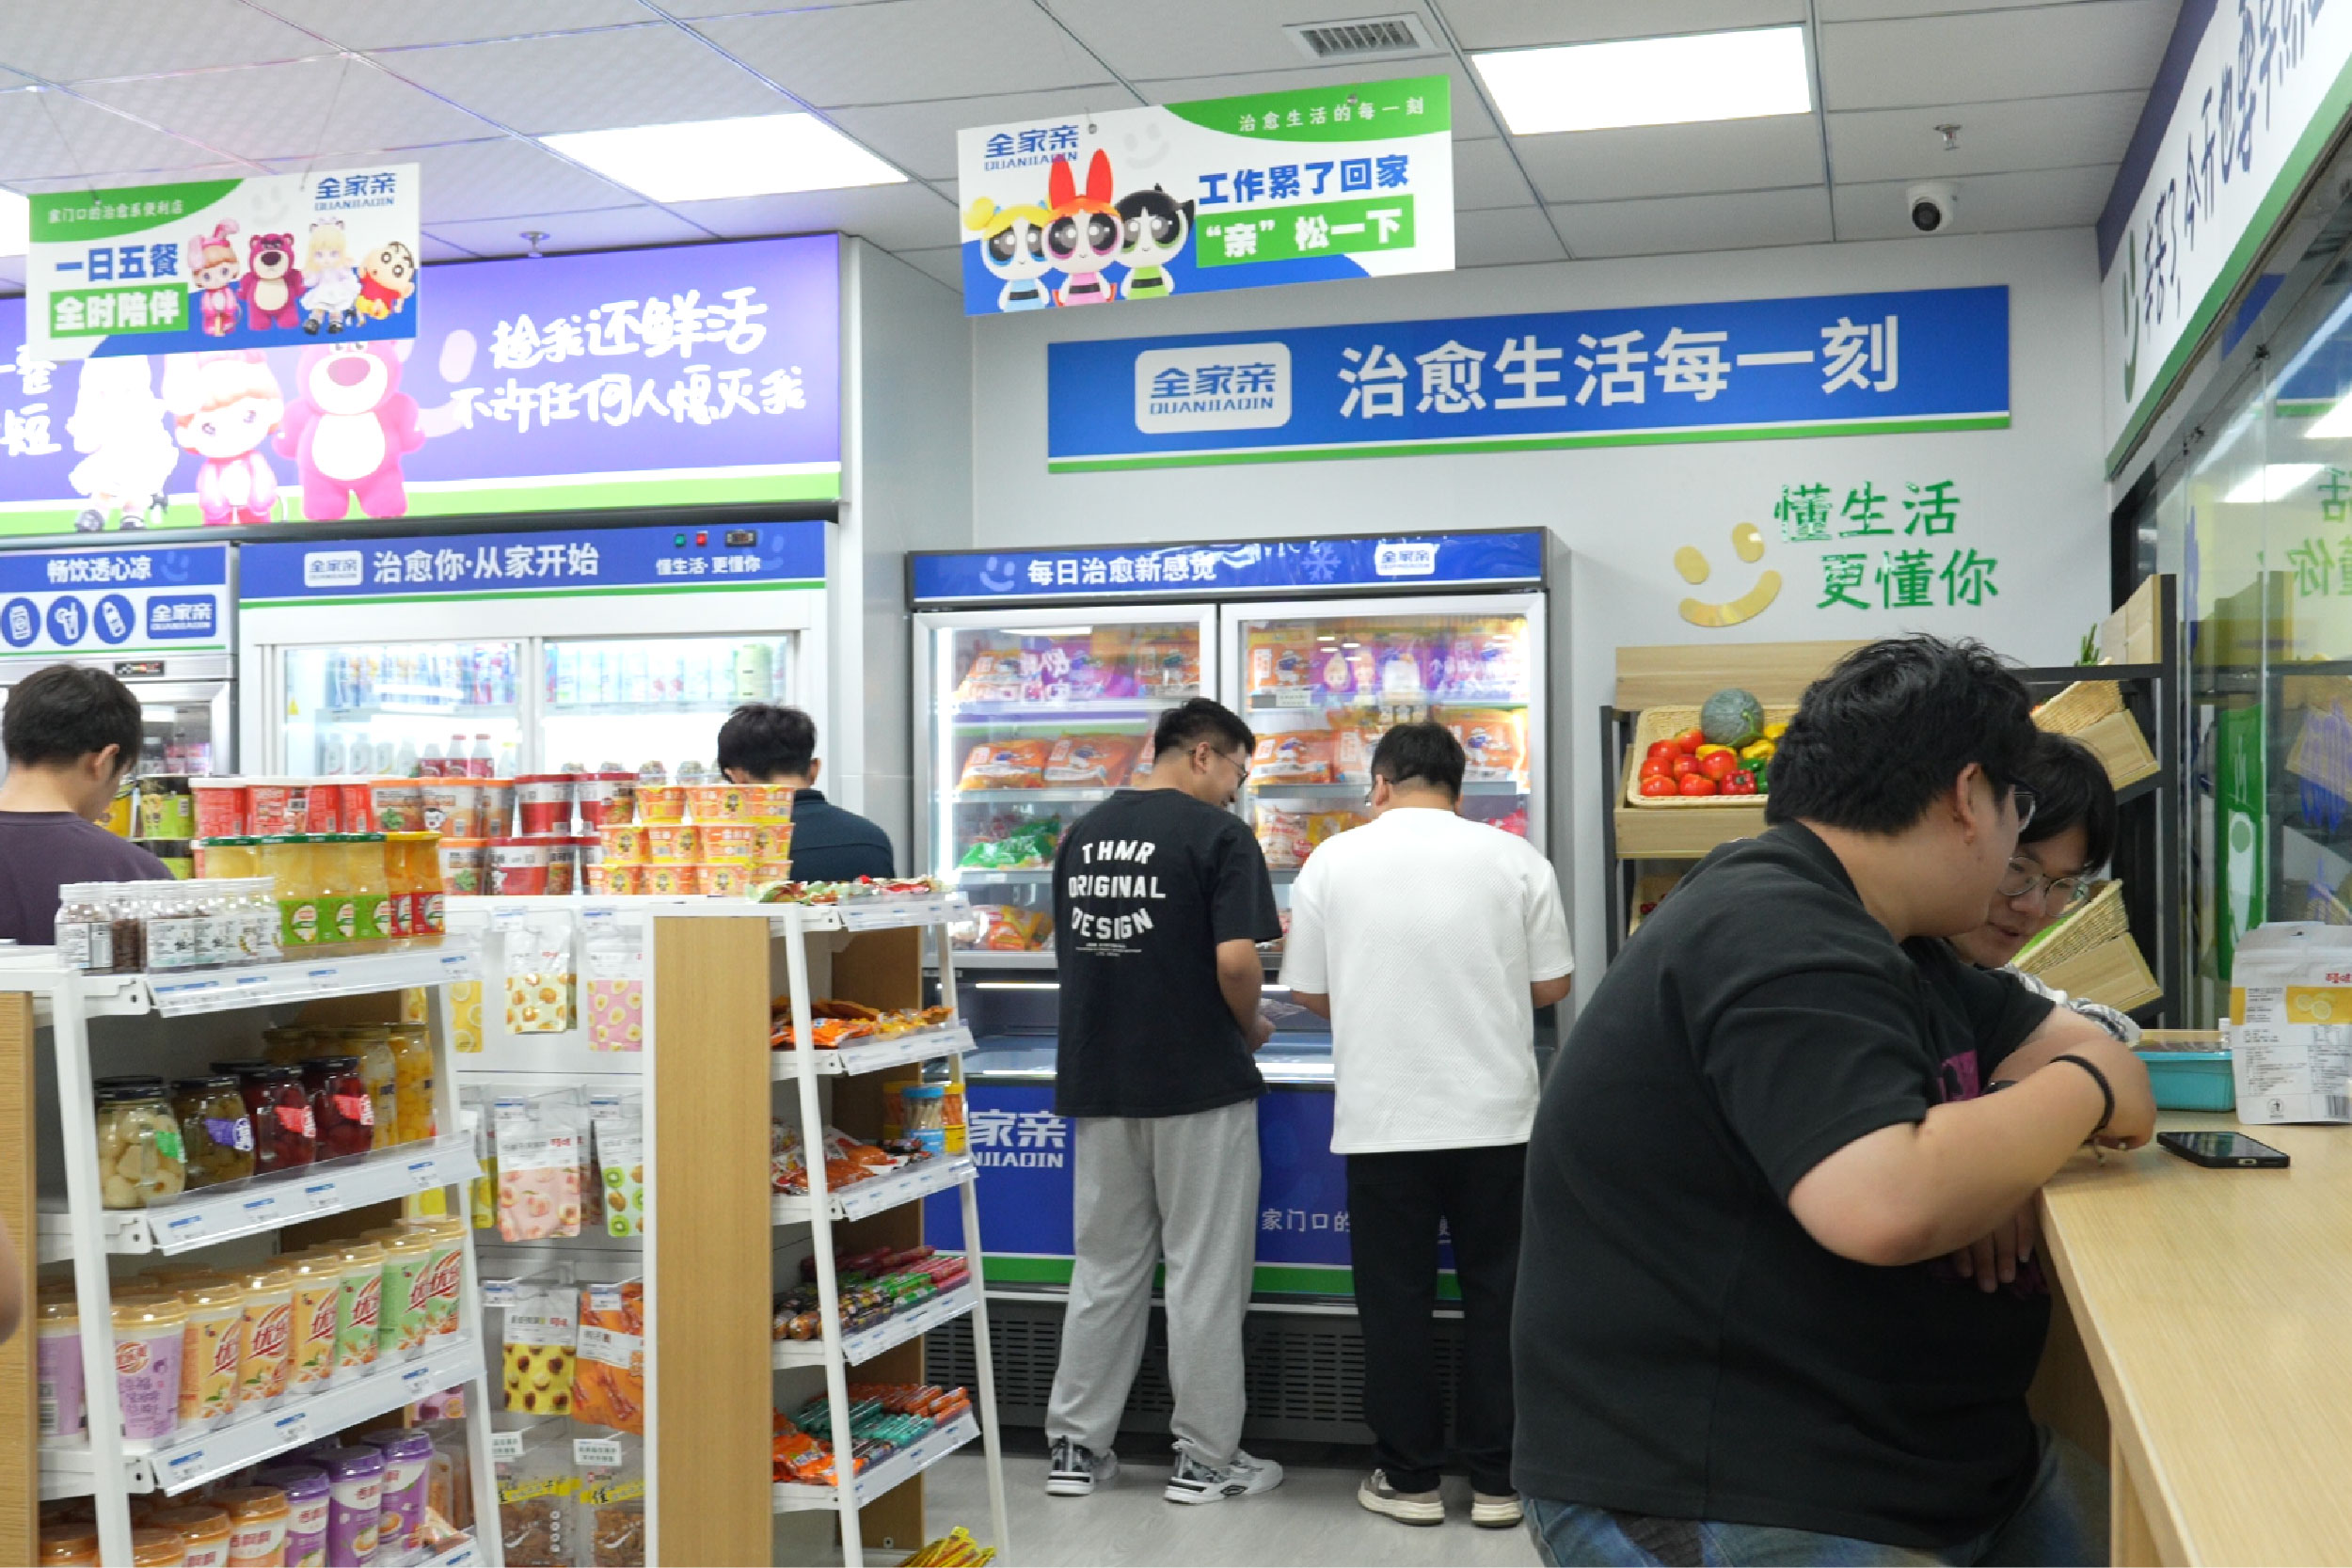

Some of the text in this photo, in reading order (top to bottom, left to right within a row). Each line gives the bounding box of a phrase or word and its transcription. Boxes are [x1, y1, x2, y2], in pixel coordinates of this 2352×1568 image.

[1239, 96, 1424, 132] 治愈生活的每一刻
[984, 124, 1079, 158] 全家亲
[315, 172, 397, 199] 全家亲
[1198, 153, 1409, 206] 工作累了回家
[55, 243, 179, 282] 一日五餐
[55, 289, 181, 331] 全时陪伴
[1151, 361, 1277, 399] 全家亲
[1337, 317, 1899, 419] 治愈生活每一刻
[1774, 480, 1961, 542] 懂生活
[47, 554, 153, 584] 畅饮透心凉
[373, 542, 600, 584] 治愈你·从家开始
[1027, 550, 1217, 585] 每日治愈新感觉
[1817, 547, 1998, 610] 更懂你
[1068, 874, 1167, 898] ORIGINAL
[1071, 906, 1154, 941] DESIGN
[1262, 1208, 1351, 1232] 家门口的
